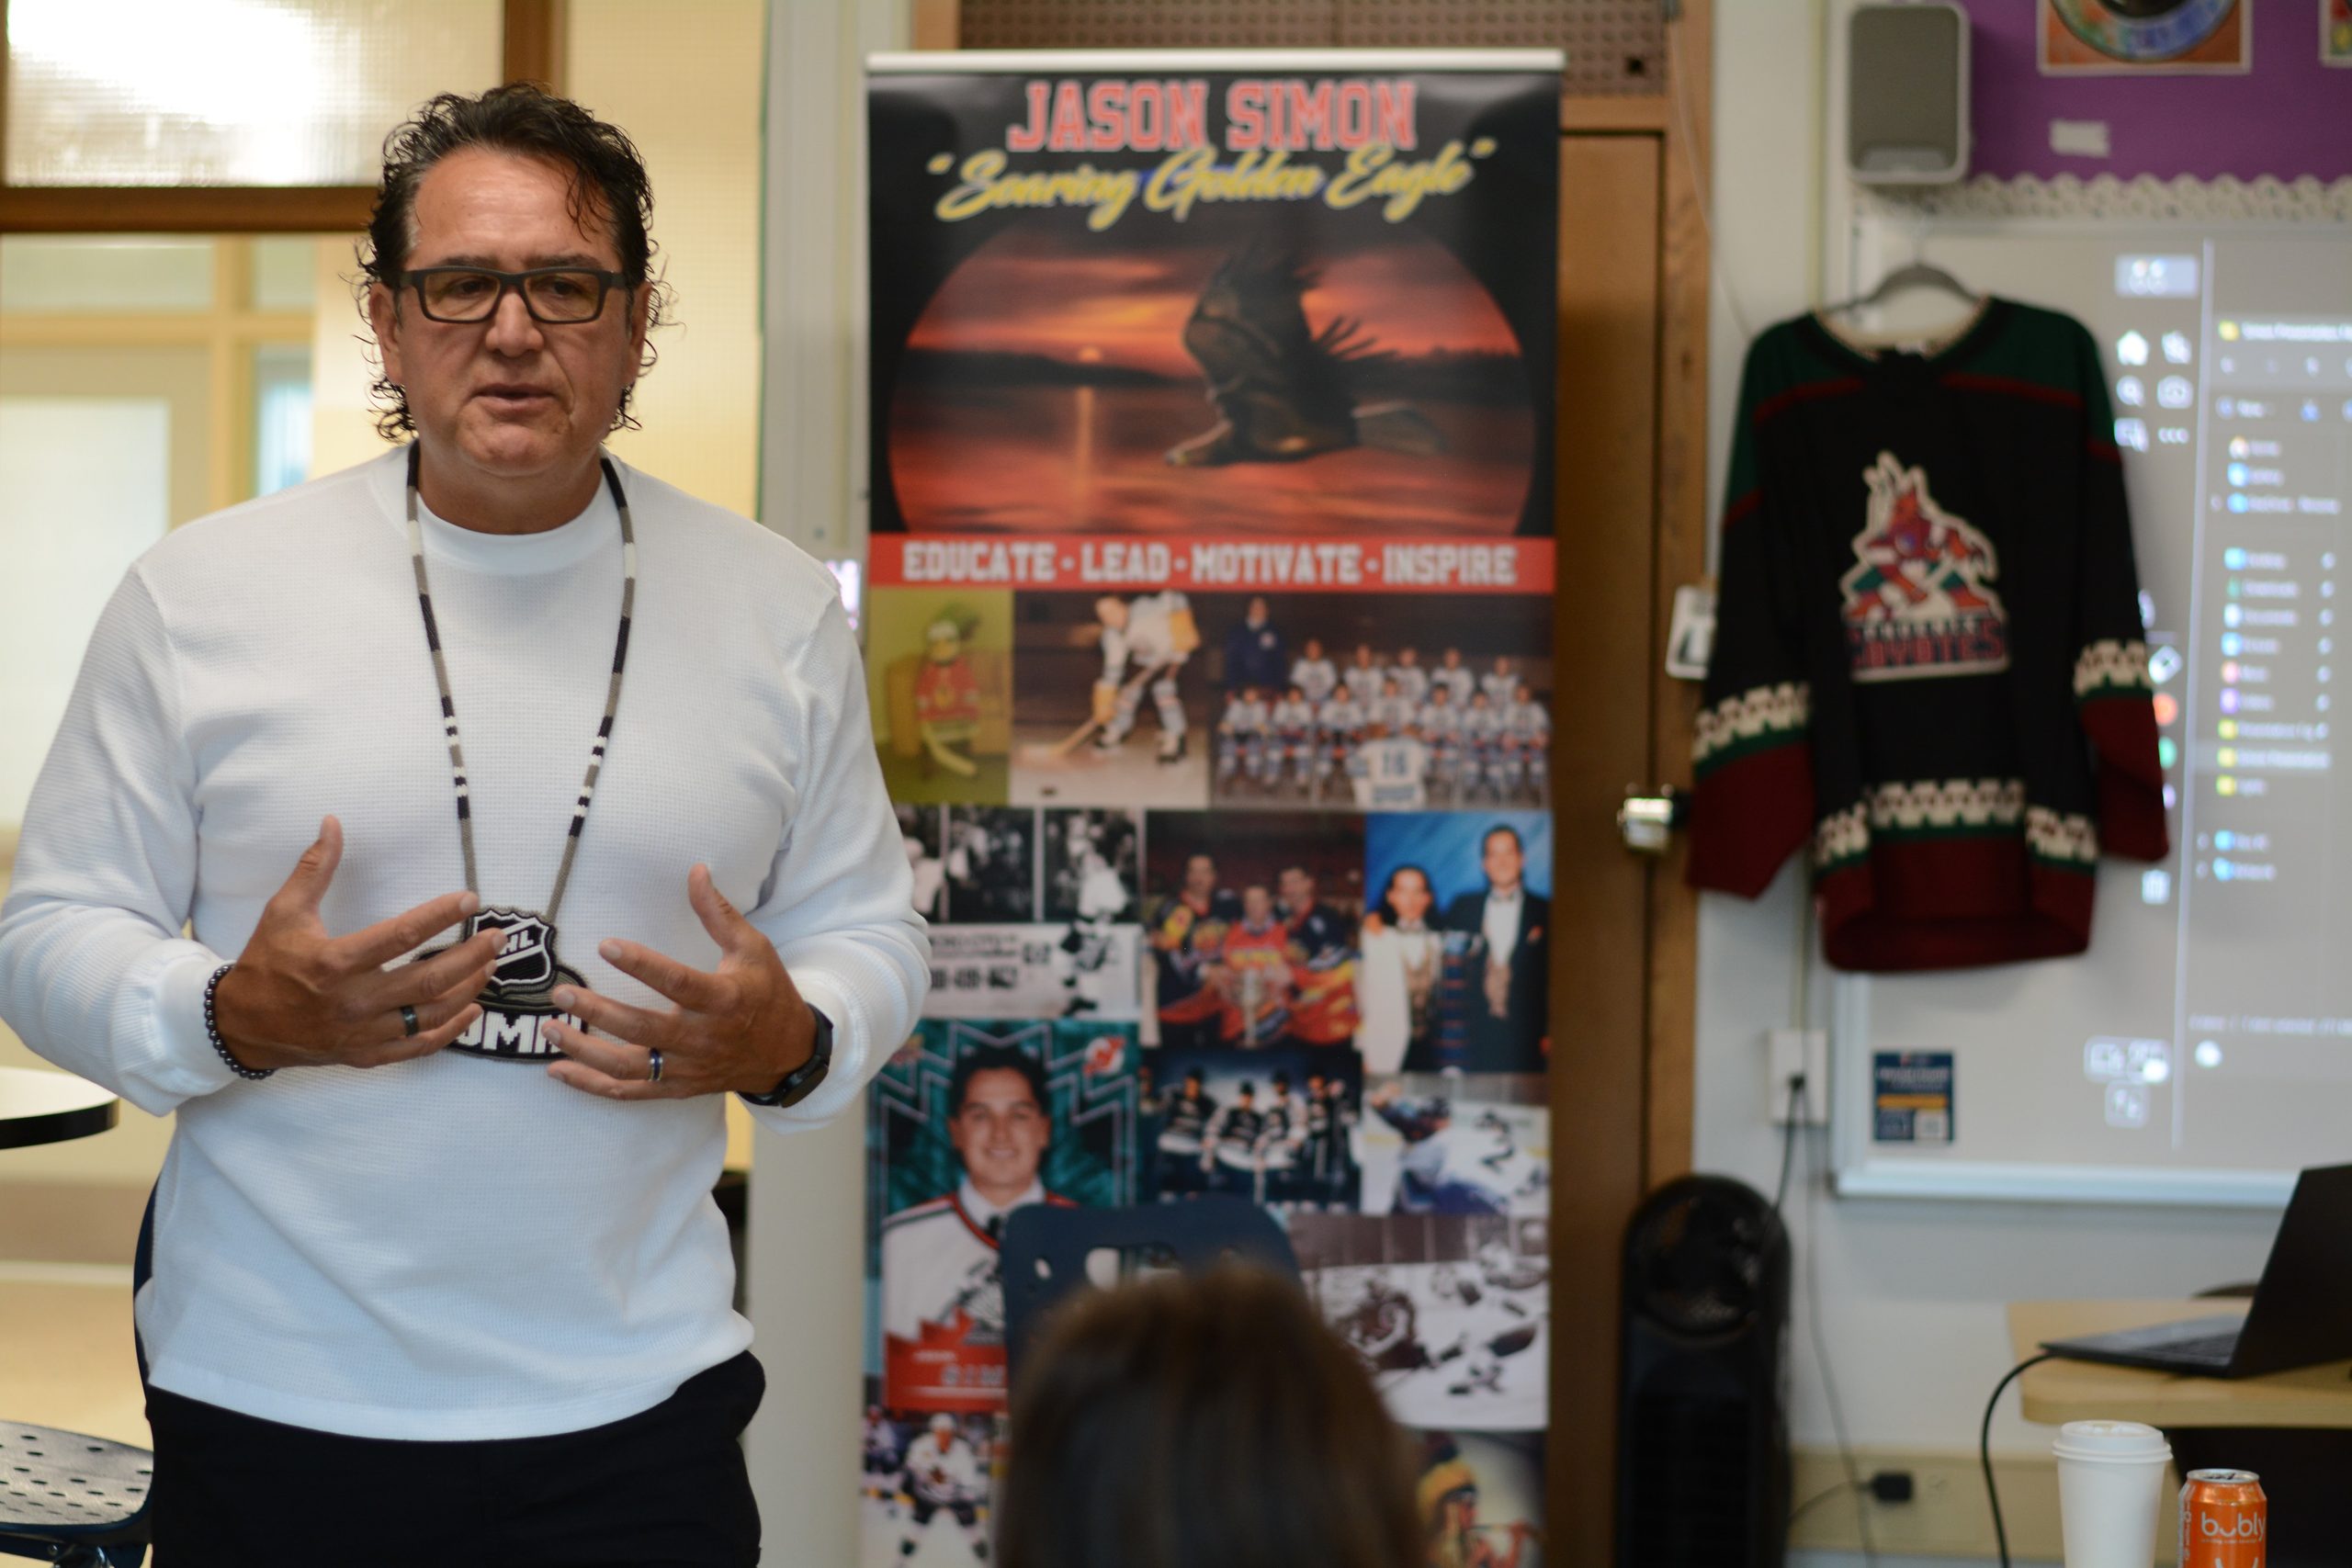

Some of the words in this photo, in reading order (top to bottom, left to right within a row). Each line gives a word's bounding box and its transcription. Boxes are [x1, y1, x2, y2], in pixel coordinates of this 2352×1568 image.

[1007, 79, 1209, 152] JASON
[1227, 80, 1418, 152] SIMON
[1144, 143, 1327, 223] Golden
[902, 541, 1057, 583] EDUCATE
[1080, 543, 1172, 583] LEAD
[1191, 543, 1363, 585] MOTIVATE
[1382, 545, 1519, 585] INSPIRE
[499, 930, 535, 956] HL
[2200, 1511, 2267, 1542] bubly
